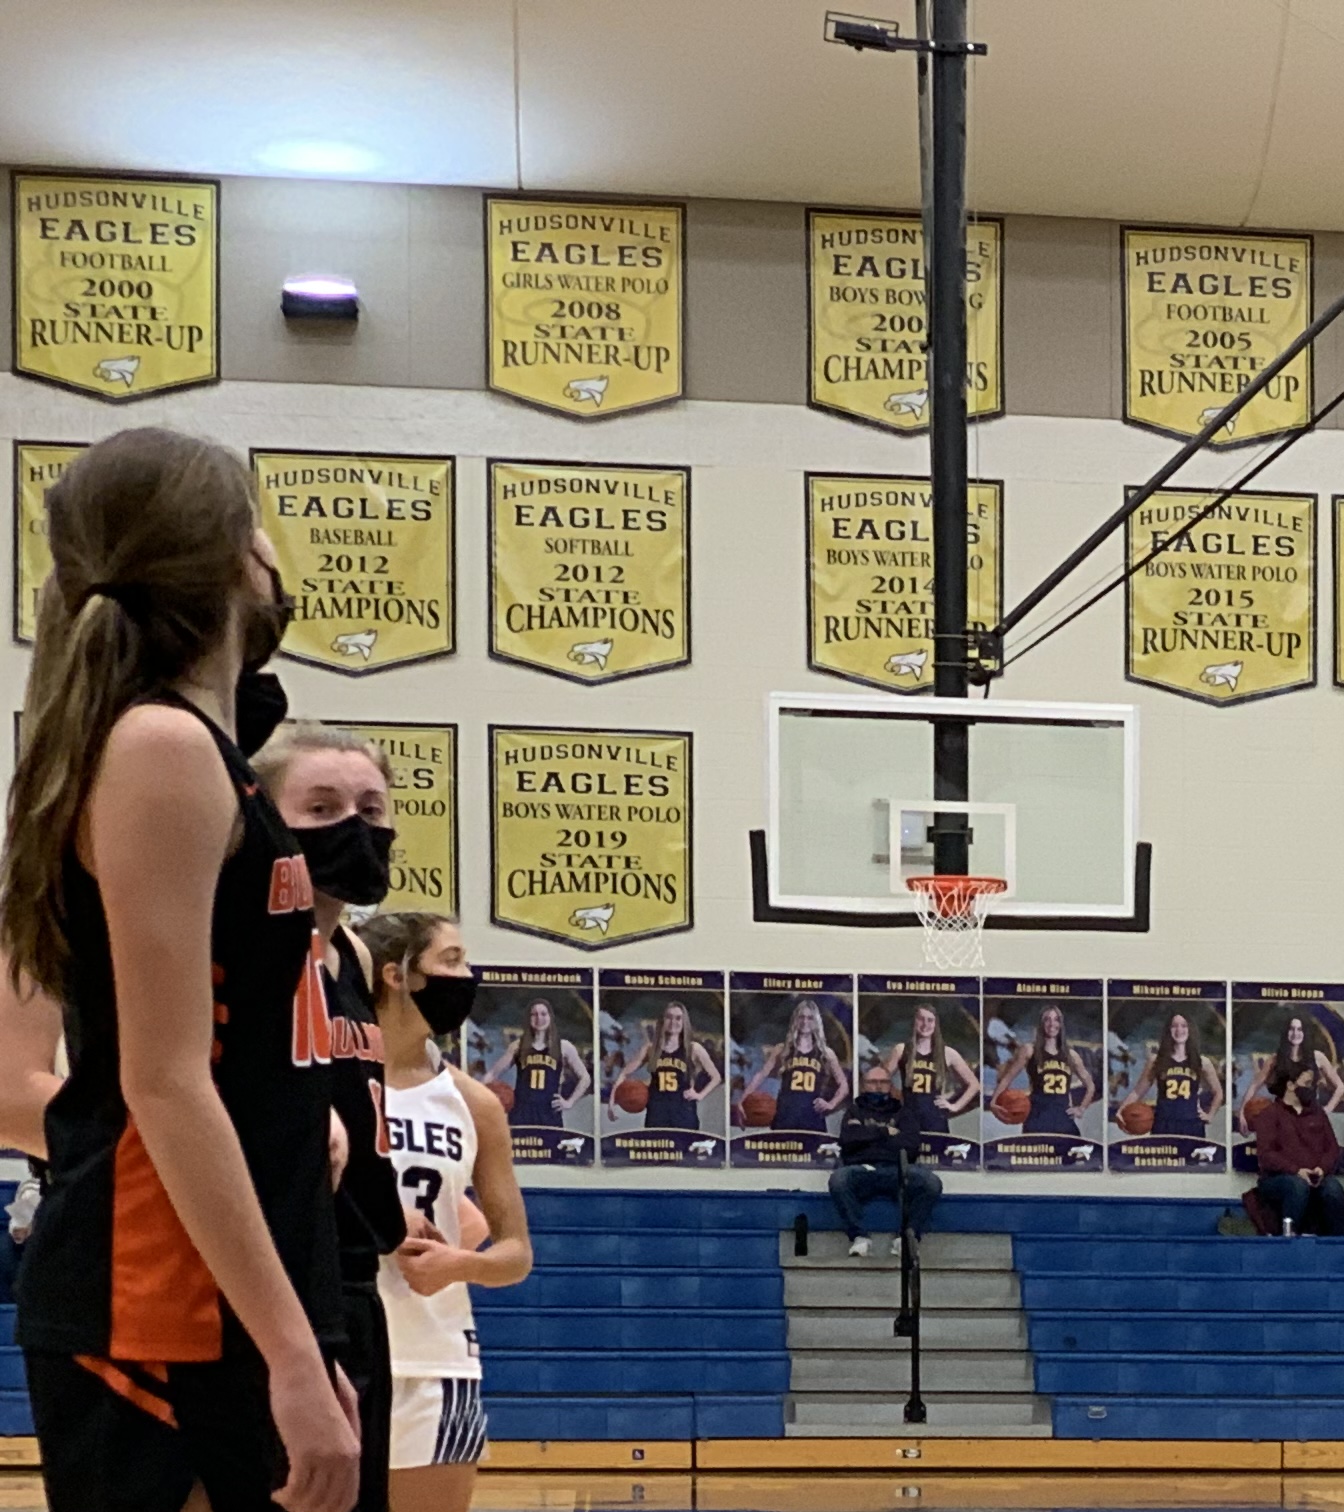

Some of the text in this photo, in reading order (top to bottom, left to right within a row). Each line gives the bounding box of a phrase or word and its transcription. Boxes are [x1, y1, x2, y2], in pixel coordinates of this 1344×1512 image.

[27, 189, 205, 221] HUDSONVILLE
[39, 219, 196, 247] EAGLES
[500, 214, 672, 243] HUDSONVILLE
[60, 250, 172, 273] FOOTBALL
[511, 242, 663, 269] EAGLES
[1135, 245, 1300, 275] HUDSONVILLE
[833, 255, 981, 282] EAGLS
[81, 279, 152, 300] 2000
[502, 272, 668, 295] GIRLS WATER POLO
[1148, 273, 1292, 298] EAGLES
[829, 286, 982, 309] BOYS BOWG
[63, 303, 168, 321] STATE
[551, 301, 620, 320] 2008
[1166, 304, 1269, 323] FOOTBALL
[30, 320, 202, 353] RUNNER-UP
[534, 324, 636, 341] STATE
[1185, 330, 1252, 349] 2005
[502, 340, 670, 372] RUNNER-UP
[1170, 352, 1266, 370] STATE
[824, 355, 987, 391] CHAMPNS
[1139, 368, 1300, 401] RUNNERUP
[266, 468, 441, 495] HUDSONVILLE
[503, 478, 676, 506] HUDSONVILLE
[277, 495, 432, 521] EAGLES
[821, 491, 988, 519] HUDSONVE
[515, 505, 668, 532] EAGLES
[310, 527, 397, 547] BASEBALL
[832, 518, 980, 544] EAGLS
[544, 538, 634, 557] SOFTBALL
[1151, 531, 1295, 557] EAGLES
[317, 555, 389, 574] 2012
[827, 549, 931, 567] BOYS WATER
[555, 565, 626, 583] 2012
[1145, 562, 1298, 584] BOYS WATER POLO
[302, 578, 405, 597] STATE
[538, 587, 641, 604] STATE
[1188, 588, 1254, 607] 2015
[286, 596, 439, 631] HAMPIONS
[856, 600, 935, 614] STAT
[506, 604, 674, 639] CHAMPIONS
[1173, 611, 1269, 628] STATE
[1142, 628, 1301, 659] RUNNER-UP
[505, 744, 678, 772] HUDSONVILLE
[516, 771, 669, 798] EAGLES
[394, 799, 446, 817] POLO
[502, 802, 681, 824] BOYS WATER POLO
[556, 829, 627, 849] 2019
[540, 852, 642, 870] STATE
[508, 870, 677, 904] CHAMPIONS
[530, 1069, 545, 1089] 11
[659, 1072, 677, 1092] 15
[791, 1071, 816, 1092] 20
[912, 1075, 930, 1093] 21
[1043, 1075, 1067, 1094] 23
[1166, 1080, 1190, 1099] 24
[386, 1117, 462, 1162] GLES
